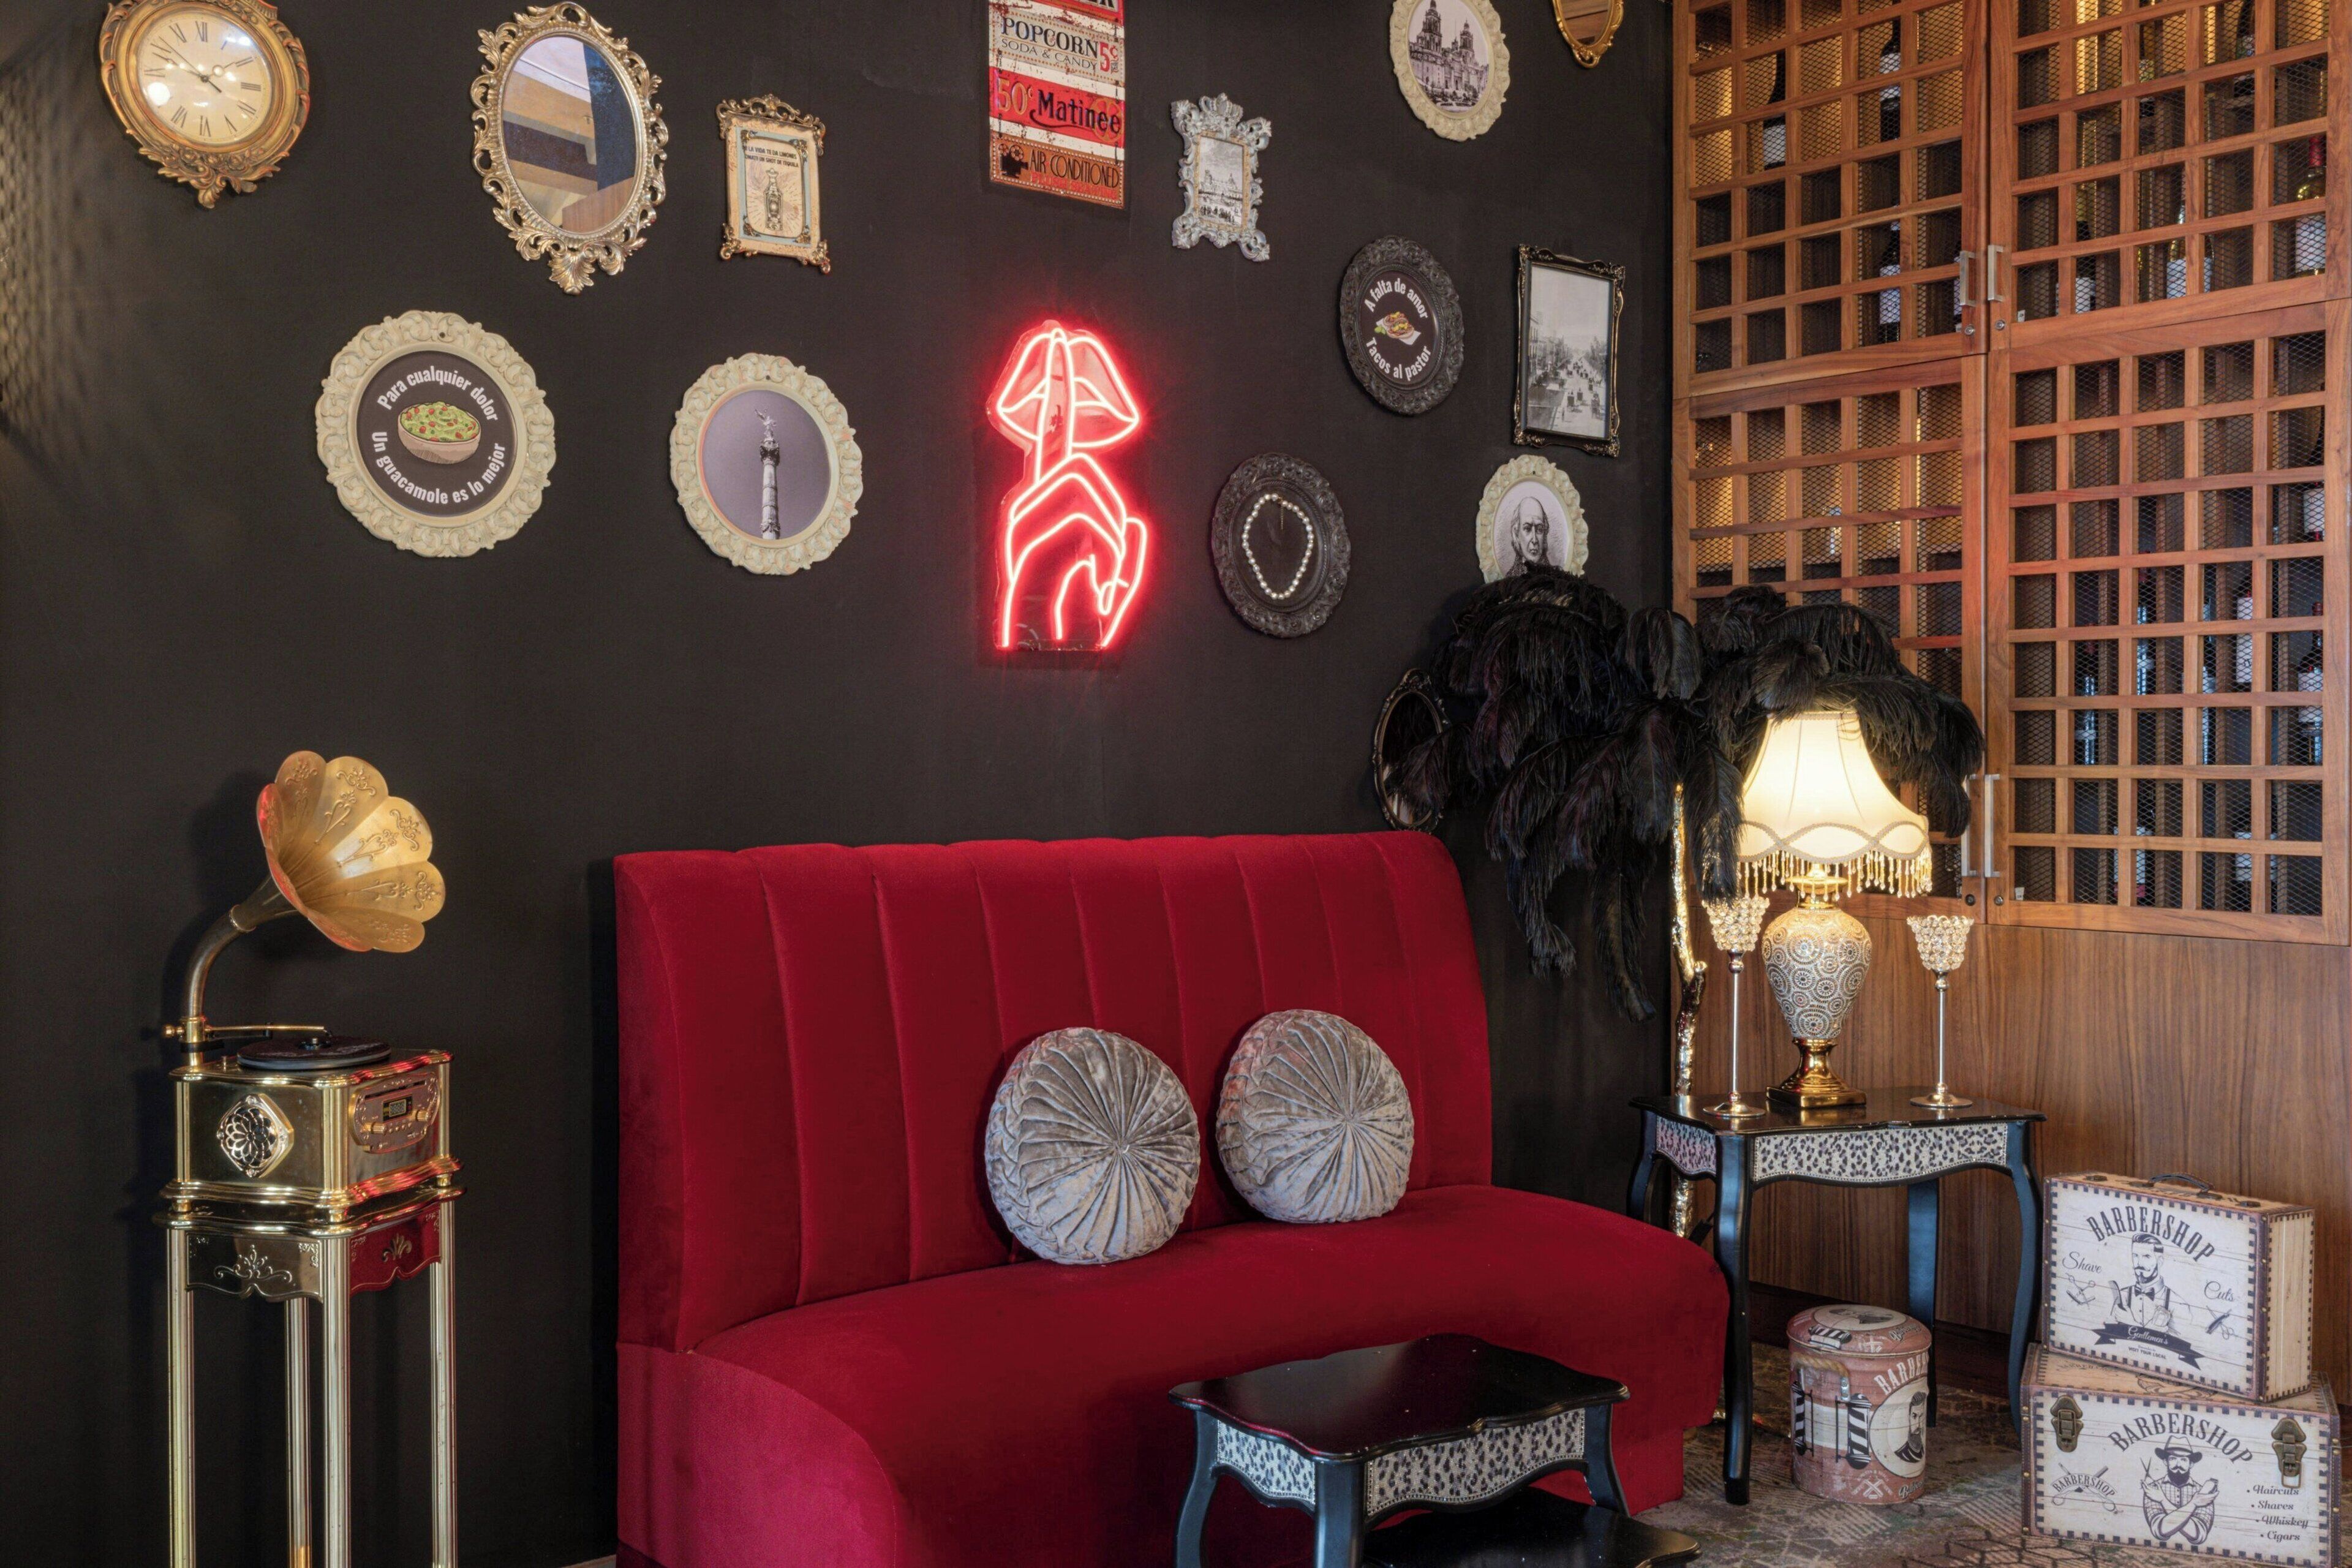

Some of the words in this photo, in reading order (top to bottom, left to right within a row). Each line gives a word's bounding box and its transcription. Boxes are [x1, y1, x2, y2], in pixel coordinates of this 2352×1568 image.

[1001, 17, 1098, 58] POPCORN
[1001, 39, 1038, 56] SODA
[1042, 50, 1050, 59] &
[1055, 53, 1097, 70] CANDY
[1037, 89, 1120, 134] Matinee
[1030, 149, 1046, 173] AIR
[1050, 154, 1119, 187] CONDITIONED
[1364, 299, 1376, 312] A
[1371, 280, 1393, 302] falta
[1394, 278, 1406, 295] de
[1406, 288, 1428, 319] amor
[1366, 337, 1390, 374] Tacos
[1393, 364, 1403, 379] al
[1405, 345, 1431, 381] pastor
[377, 380, 407, 410] Para
[406, 366, 472, 391] cualquier
[470, 386, 498, 421] dolor
[372, 431, 388, 452] Un
[482, 443, 505, 484] mejor
[376, 456, 448, 504] guacamole
[452, 488, 469, 503] es
[467, 480, 484, 496] lo
[2086, 1206, 2215, 1262] BARBERSHOP
[2062, 1252, 2101, 1274] Shave
[2204, 1280, 2235, 1303] Cuts
[2108, 1413, 2253, 1463] BARBERSHOP
[2052, 1474, 2115, 1497] BARBERSHOP
[2253, 1485, 2299, 1495] Haircuts
[2258, 1500, 2294, 1510] Shaves
[2262, 1515, 2309, 1529] Whiskey
[2267, 1531, 2300, 1543] Cigars
